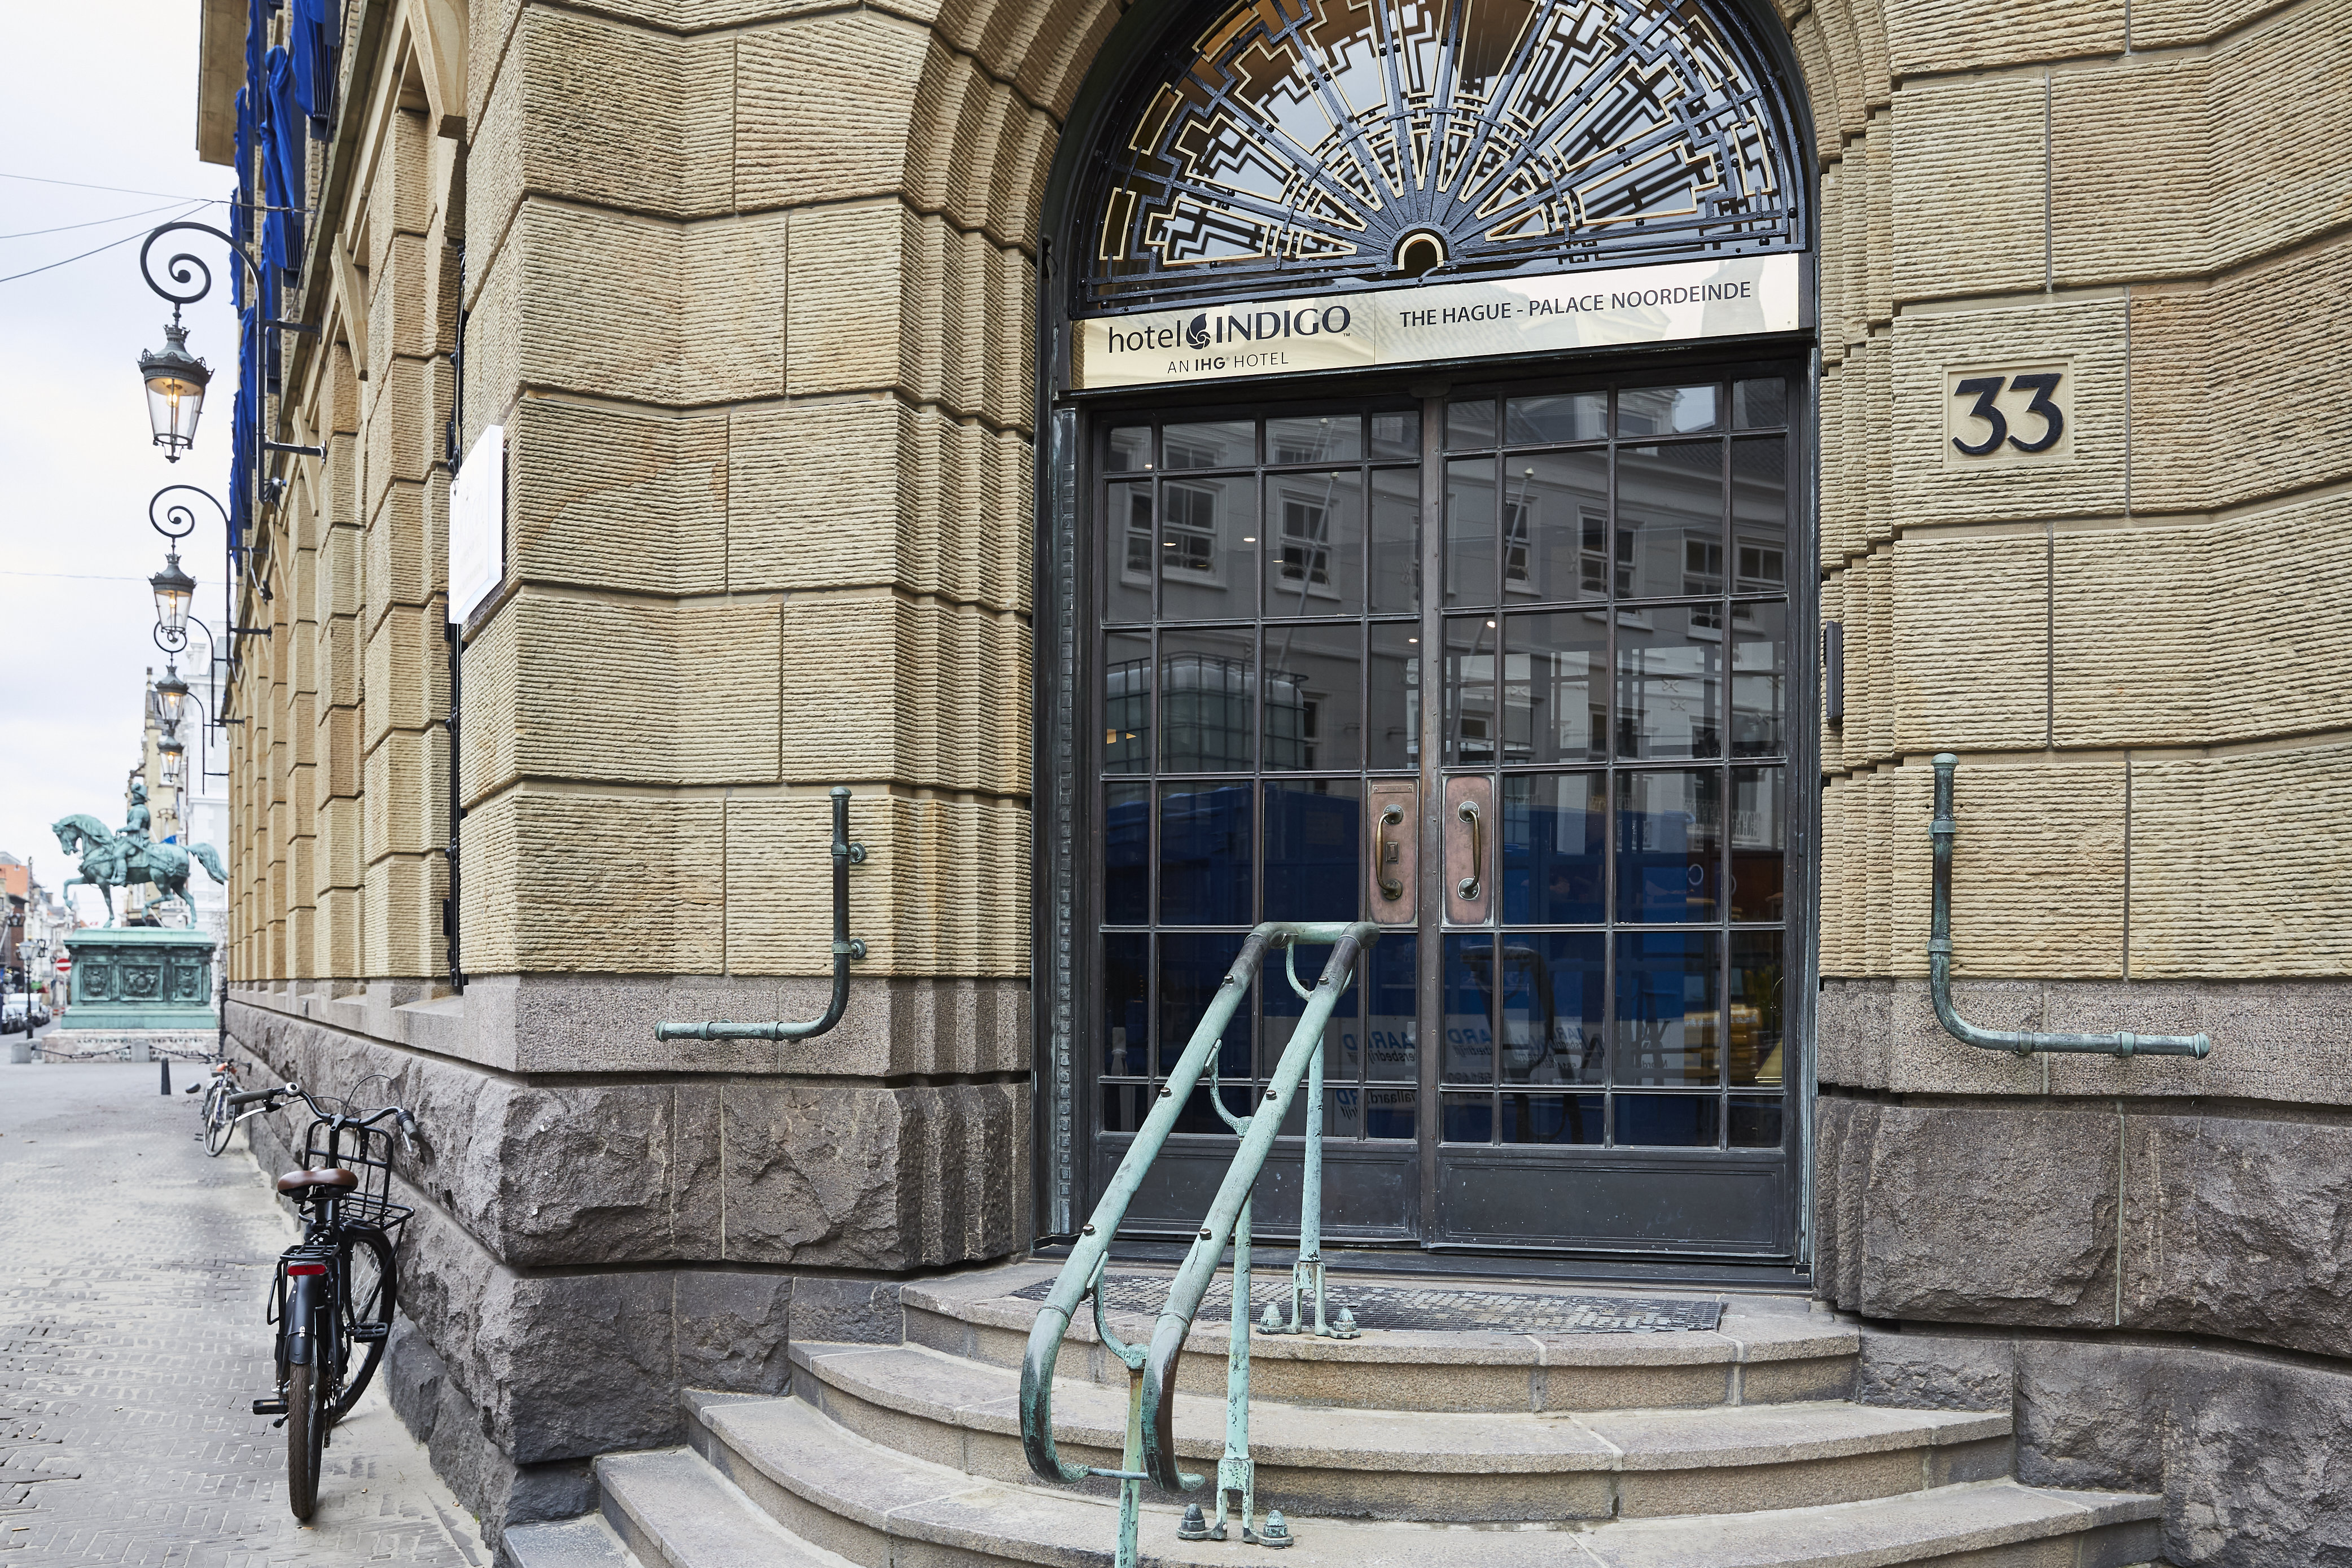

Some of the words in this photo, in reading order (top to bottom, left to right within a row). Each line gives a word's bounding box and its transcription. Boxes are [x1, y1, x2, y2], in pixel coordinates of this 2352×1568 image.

[1400, 309, 1436, 327] THE
[1443, 303, 1511, 323] HAGUE
[1529, 294, 1604, 317] PALACE
[1612, 281, 1751, 309] NOORDEINDE
[1109, 320, 1180, 353] hotel
[1216, 305, 1351, 343] INDIGO
[1167, 360, 1189, 374] AN
[1235, 352, 1289, 369] HOTEL
[1952, 373, 2064, 455] 33
